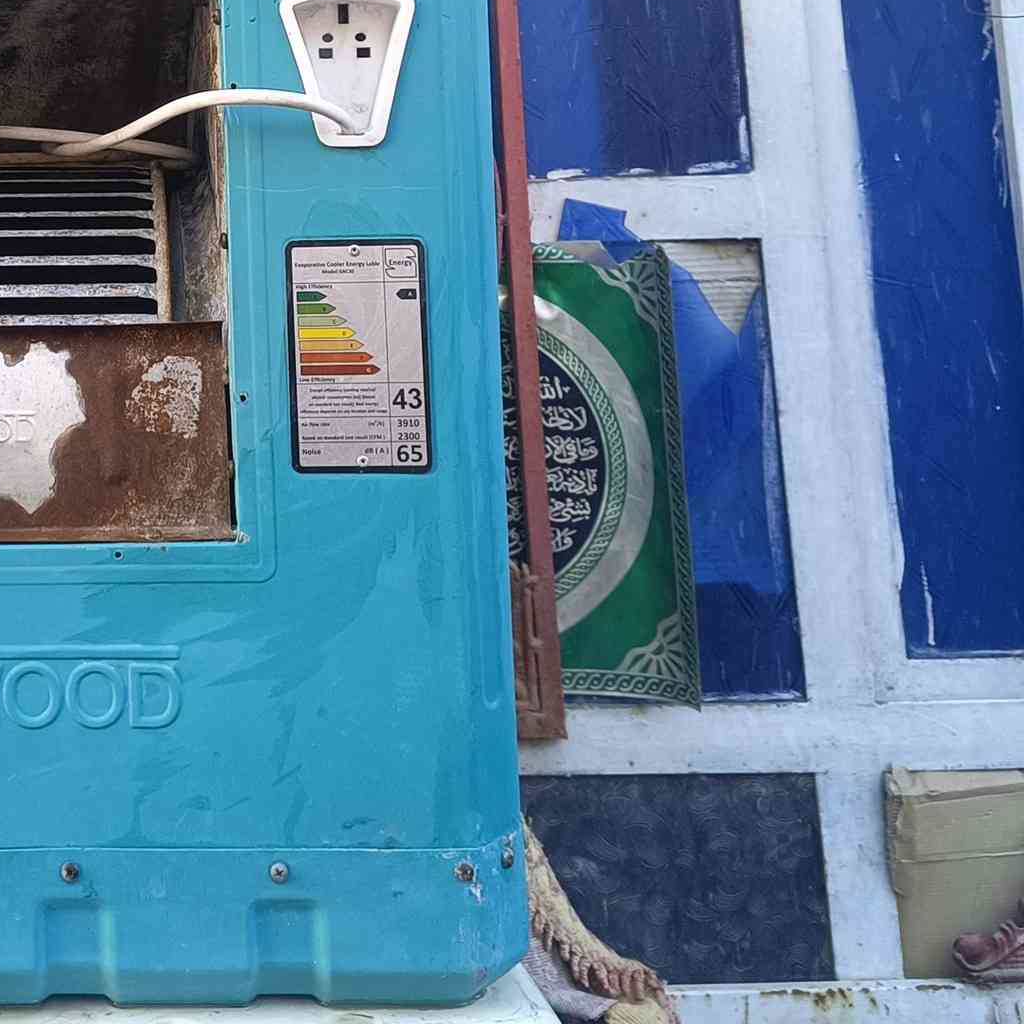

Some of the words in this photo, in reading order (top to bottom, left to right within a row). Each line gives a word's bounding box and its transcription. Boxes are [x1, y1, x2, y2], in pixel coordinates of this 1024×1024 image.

[346, 260, 365, 268] Energy
[389, 259, 413, 267] Energy
[392, 387, 423, 410] 43
[397, 418, 420, 428] 3910
[397, 431, 421, 441] 2300
[302, 448, 322, 456] Noise
[396, 444, 423, 463] 65
